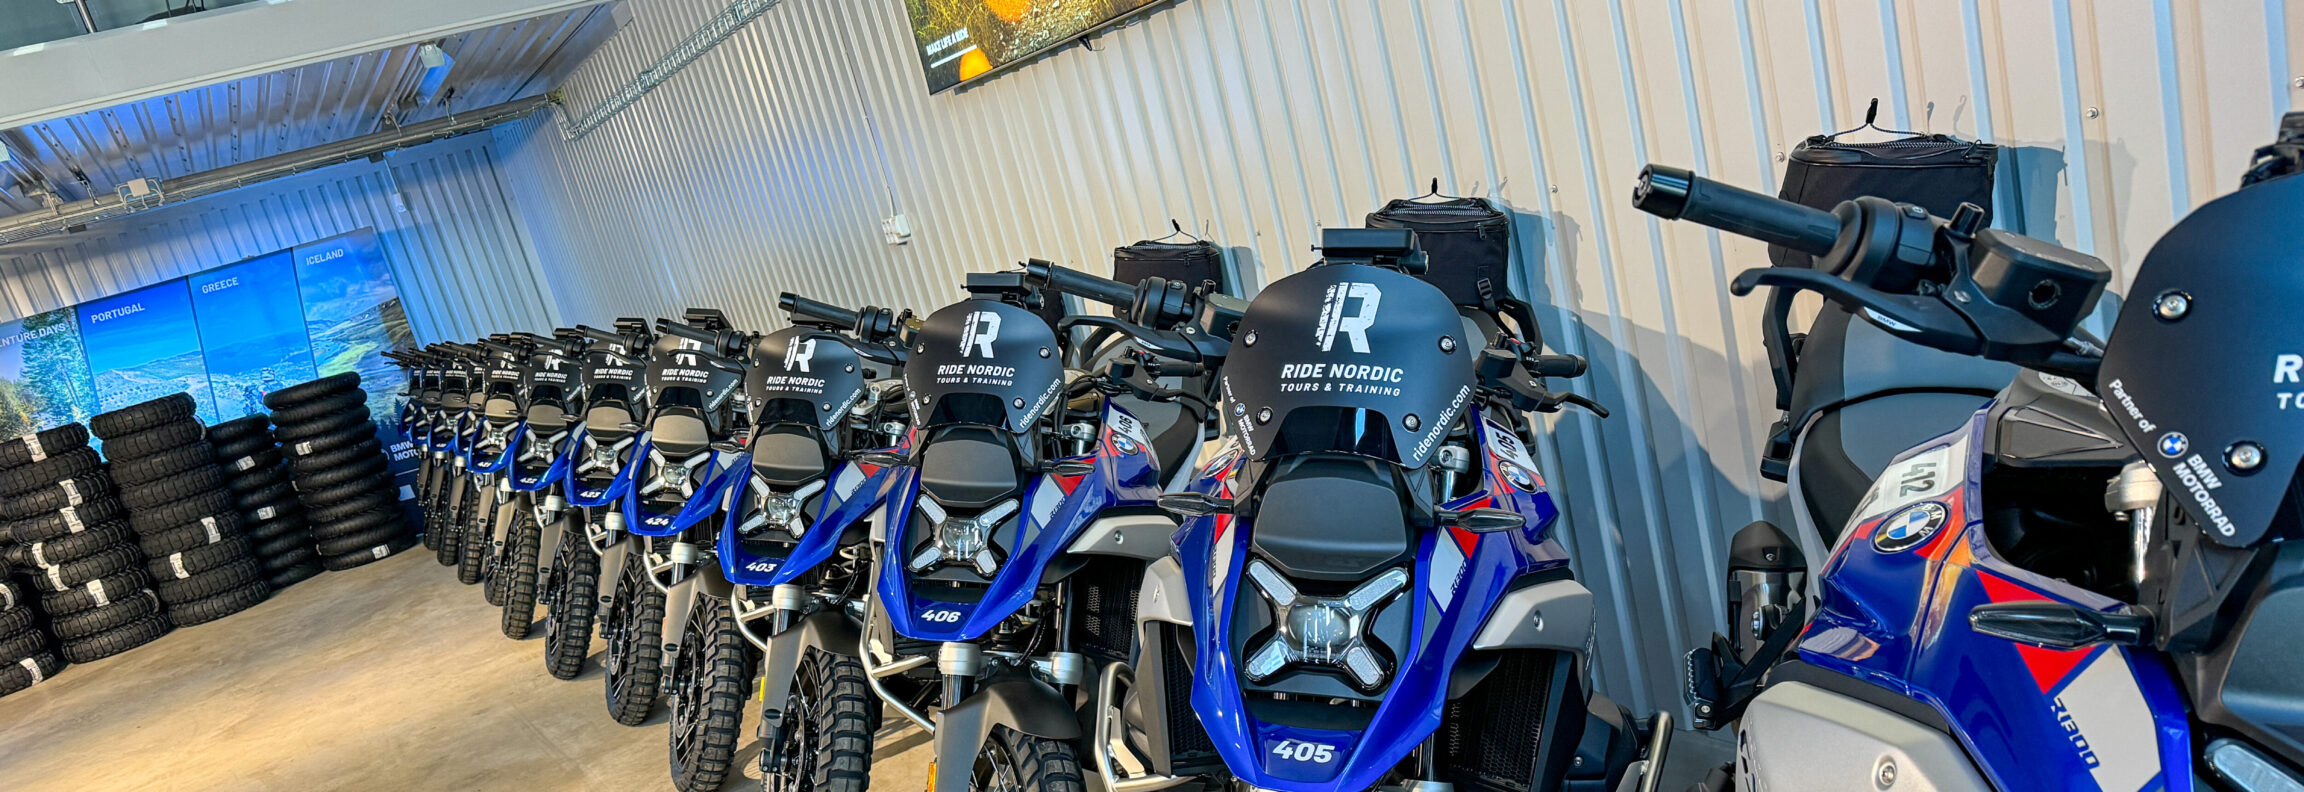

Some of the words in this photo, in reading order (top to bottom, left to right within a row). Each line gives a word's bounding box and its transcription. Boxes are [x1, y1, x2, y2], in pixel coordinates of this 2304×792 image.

[305, 248, 344, 266] ICELAND
[202, 277, 239, 295] GREECE
[91, 302, 146, 325] PORTUGAL
[38, 322, 66, 337] DAYS
[661, 368, 679, 376] RIDE
[678, 368, 709, 378] NORDIC
[937, 364, 966, 375] RIDE
[966, 364, 1015, 378] NORDIC
[1280, 363, 1326, 379] RIDE
[1329, 363, 1404, 383] NORDIC
[766, 376, 788, 385] RIDE
[788, 376, 825, 388] NORDIC
[972, 377, 1013, 387] TRAINING
[1280, 382, 1320, 392] TOURS
[1324, 382, 1332, 392] &
[1339, 383, 1401, 397] TRAINING
[825, 388, 862, 427] ridenordic.com
[1019, 377, 1062, 429] ridenordic.com
[2109, 378, 2144, 421] Partner
[2138, 418, 2157, 433] of
[1118, 415, 1132, 434] 406
[1412, 384, 1471, 462] ridenordic.com
[390, 440, 414, 453] BMW
[1238, 418, 1256, 456] MOTORRAD
[1495, 431, 1518, 460] 405
[1899, 462, 1937, 498] 412
[2187, 453, 2223, 490] BMW
[2172, 462, 2236, 537] MOTORRAD
[644, 516, 671, 527] 424
[745, 561, 778, 573] 403
[921, 609, 962, 623] 406
[1272, 740, 1336, 764] 405
